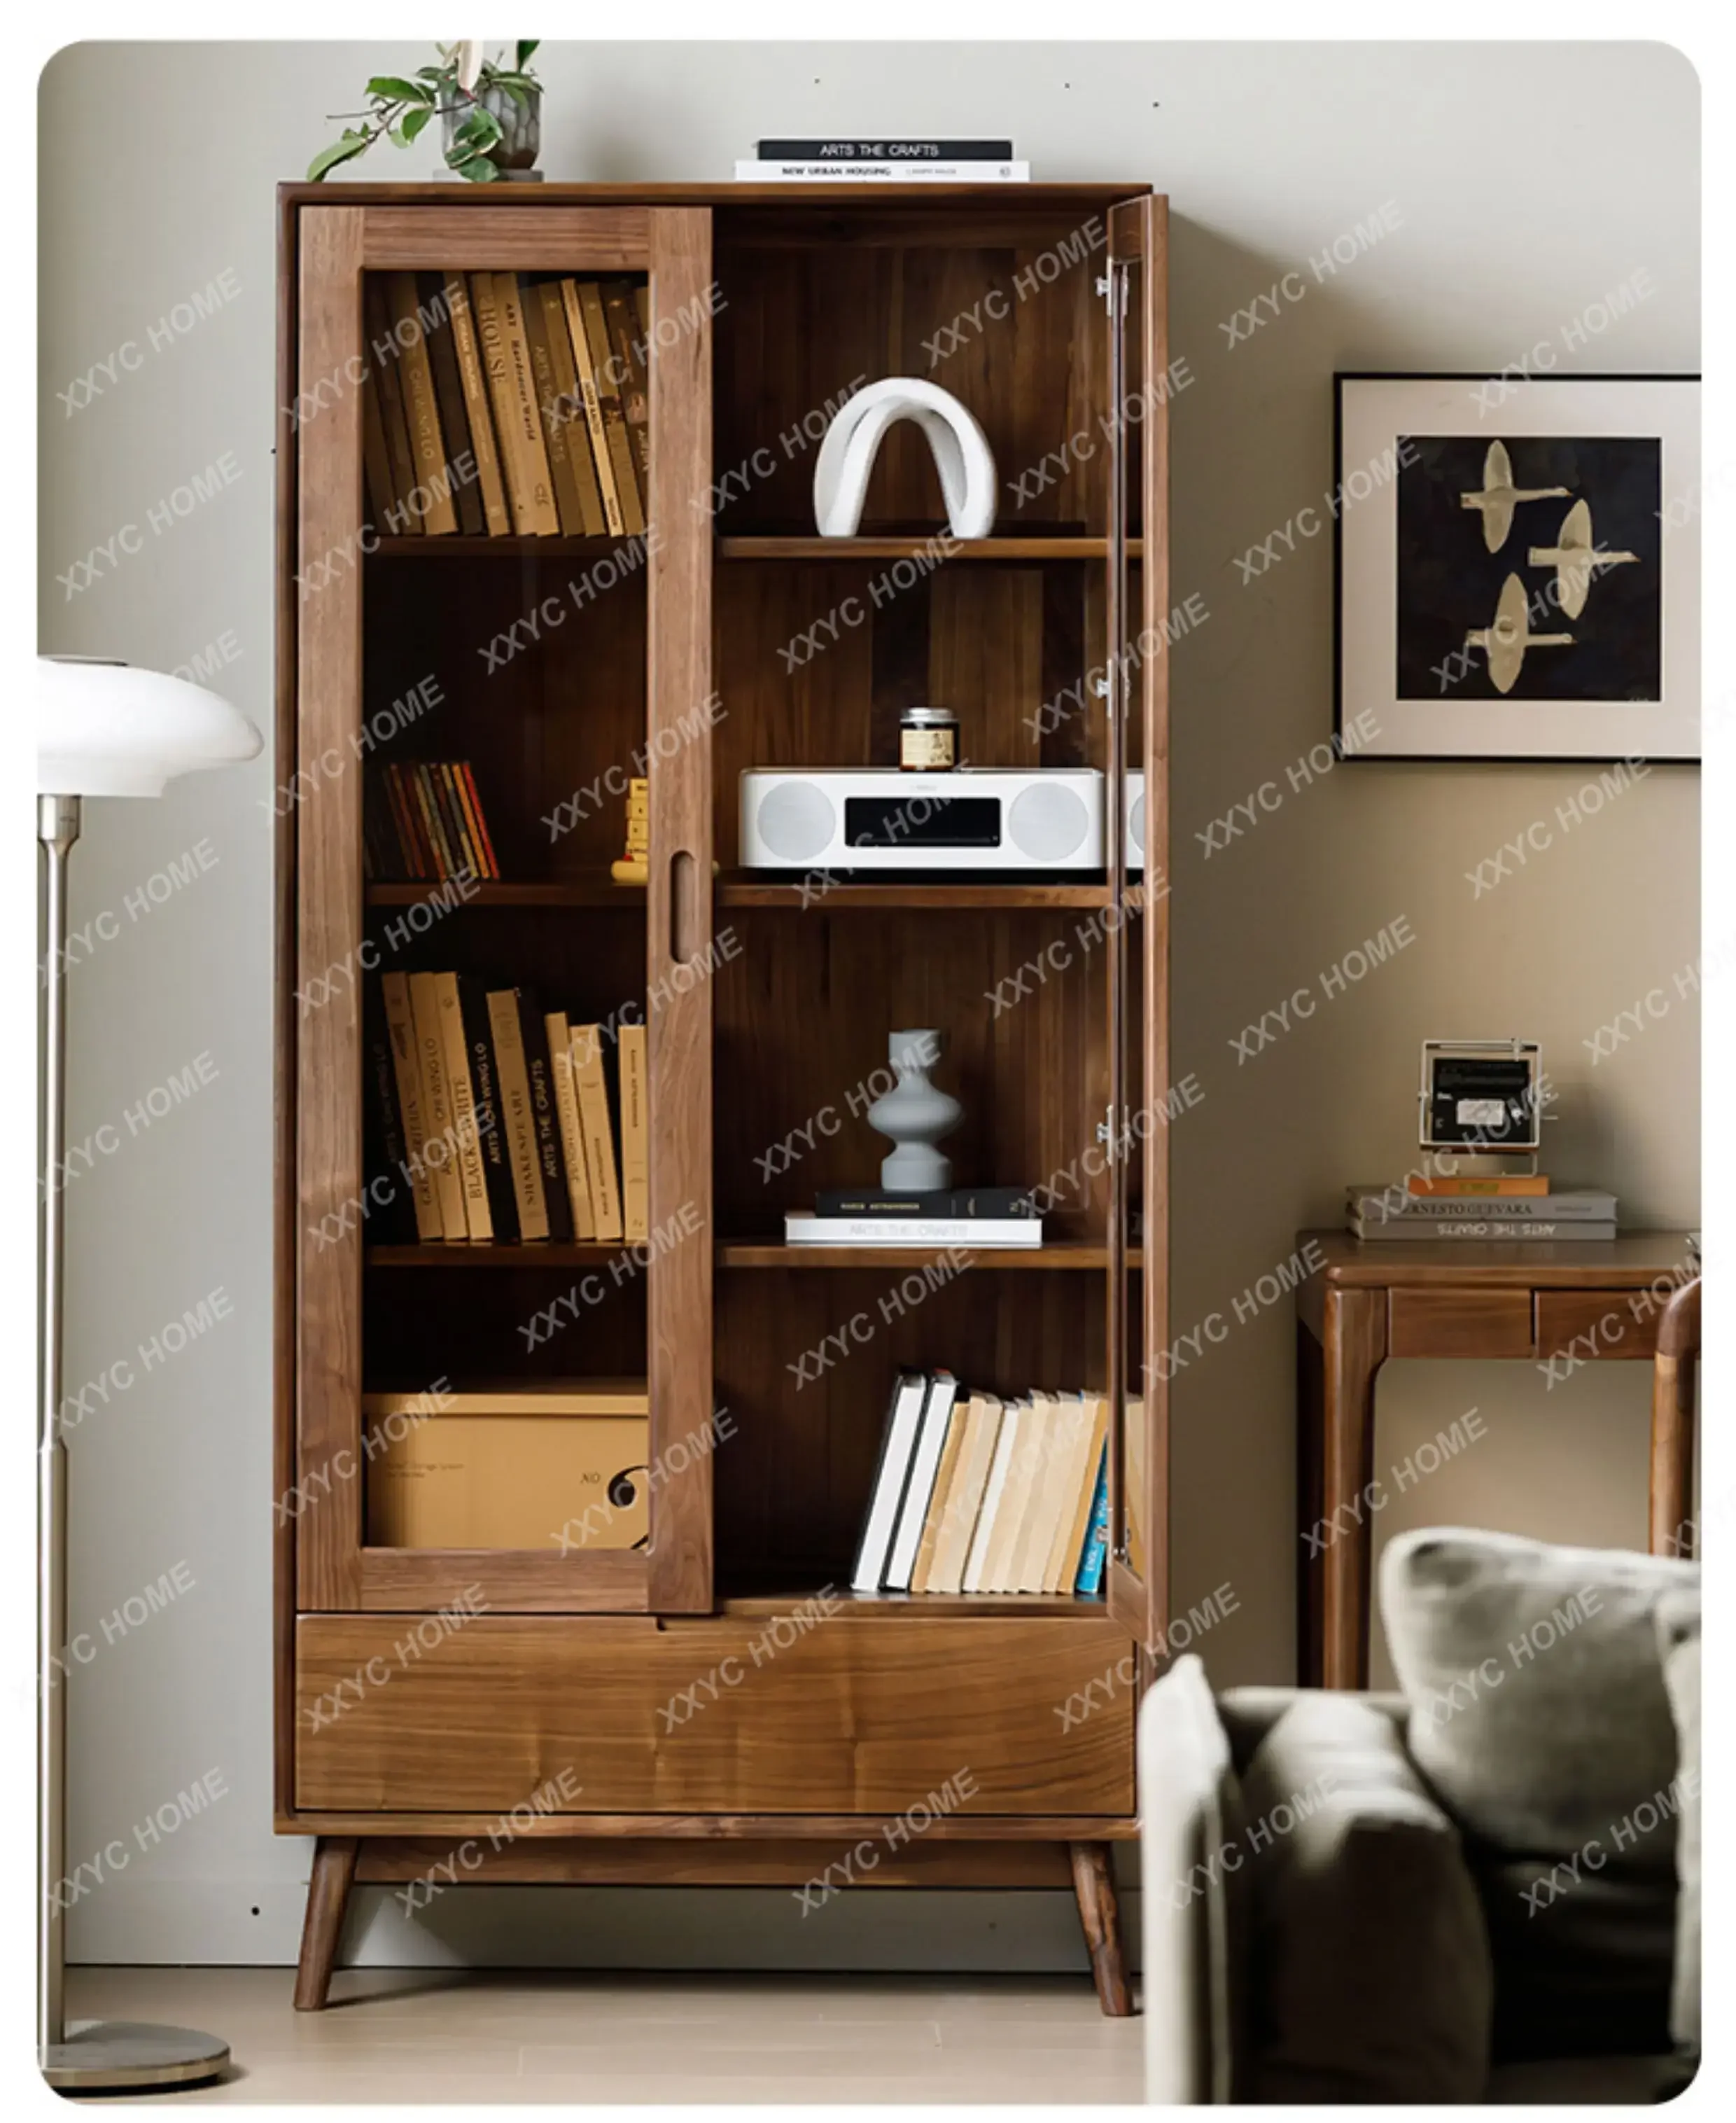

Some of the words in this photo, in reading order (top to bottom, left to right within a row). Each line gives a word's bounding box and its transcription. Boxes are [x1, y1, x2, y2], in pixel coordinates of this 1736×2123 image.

[820, 144, 855, 157] ARTS
[859, 144, 883, 157] THE
[888, 144, 940, 158] CRAFTS
[480, 308, 507, 384] HOUSE
[531, 1059, 550, 1111] CRAFTS
[538, 1114, 554, 1139] THE
[462, 1146, 483, 1199] BLACK
[542, 1143, 559, 1178] ARTS
[1466, 1202, 1533, 1216] GUEVARA
